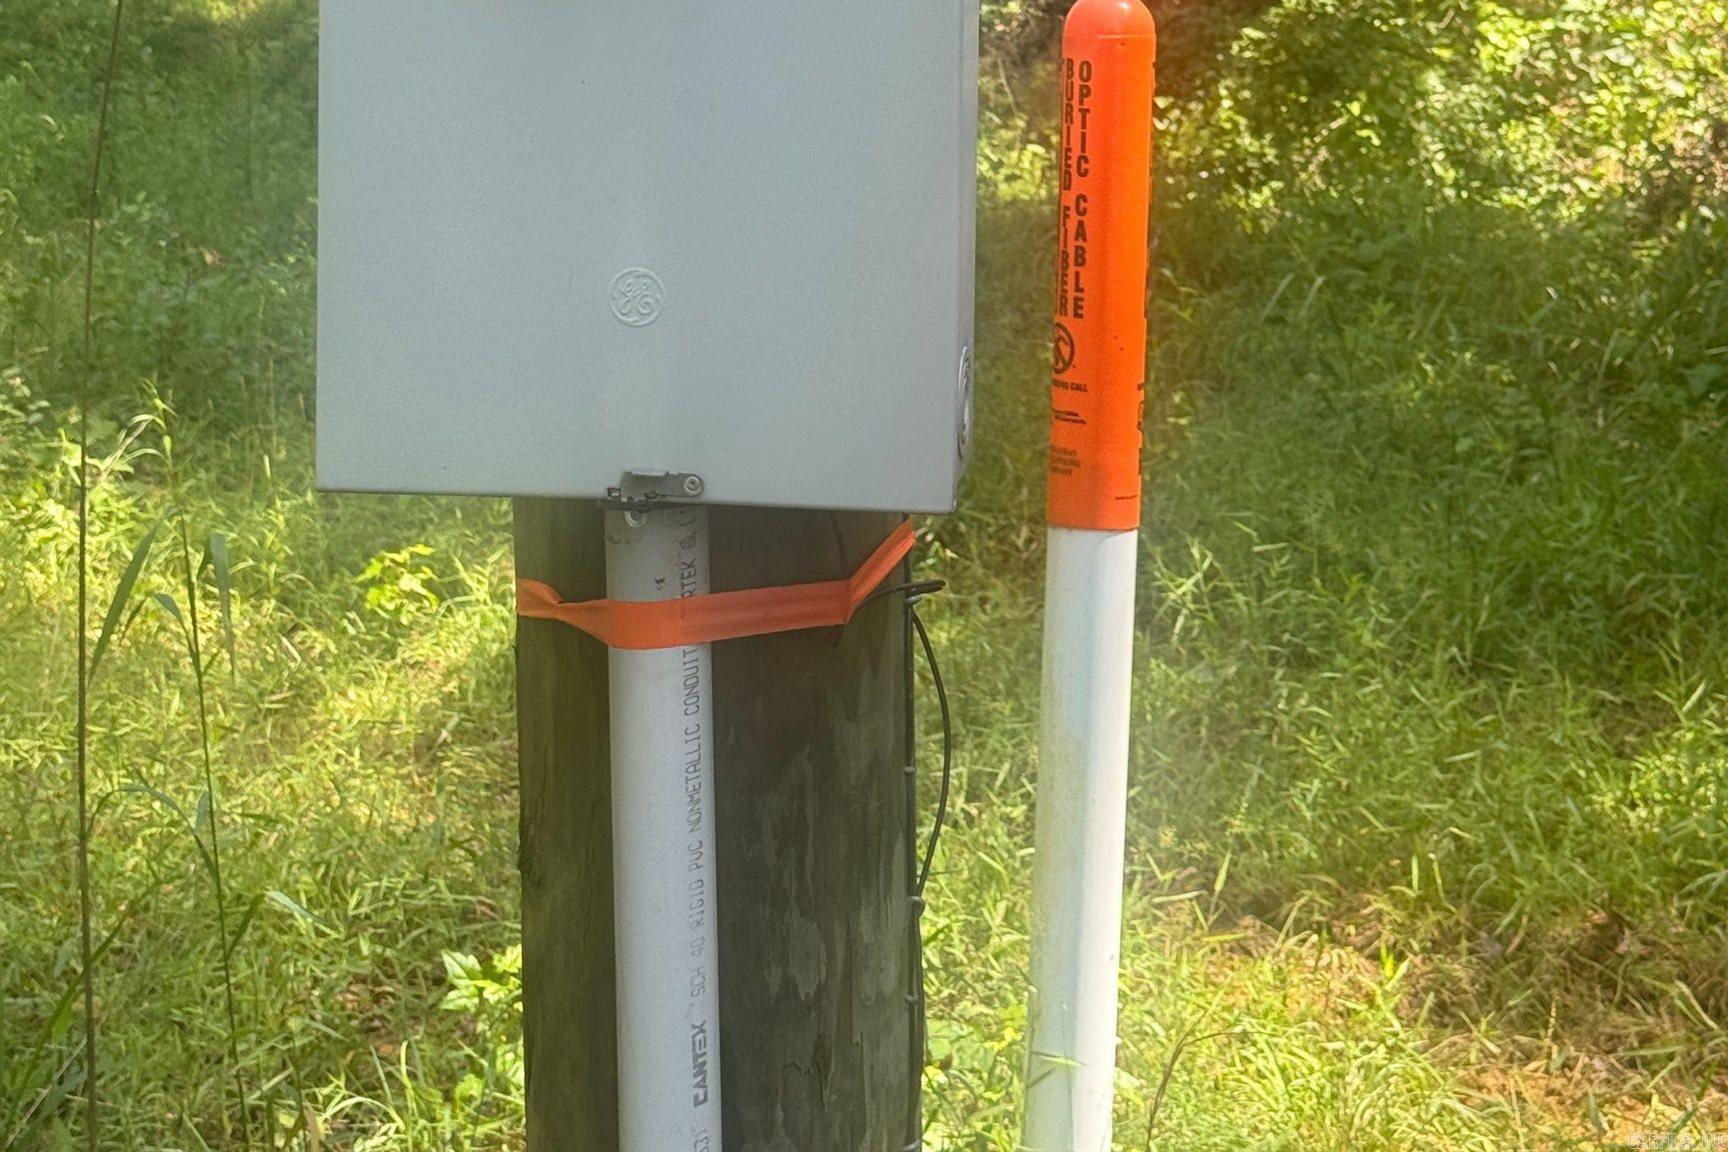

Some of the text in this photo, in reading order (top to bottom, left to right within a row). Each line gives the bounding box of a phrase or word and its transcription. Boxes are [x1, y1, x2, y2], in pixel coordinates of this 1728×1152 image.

[1063, 58, 1074, 191] BURIED
[1073, 61, 1092, 319] OPTIC CABLE
[682, 647, 700, 716] CONDUIT
[684, 723, 702, 834] NONMETALLIC
[687, 840, 703, 872] PVC
[691, 1018, 708, 1108] CANTEX
